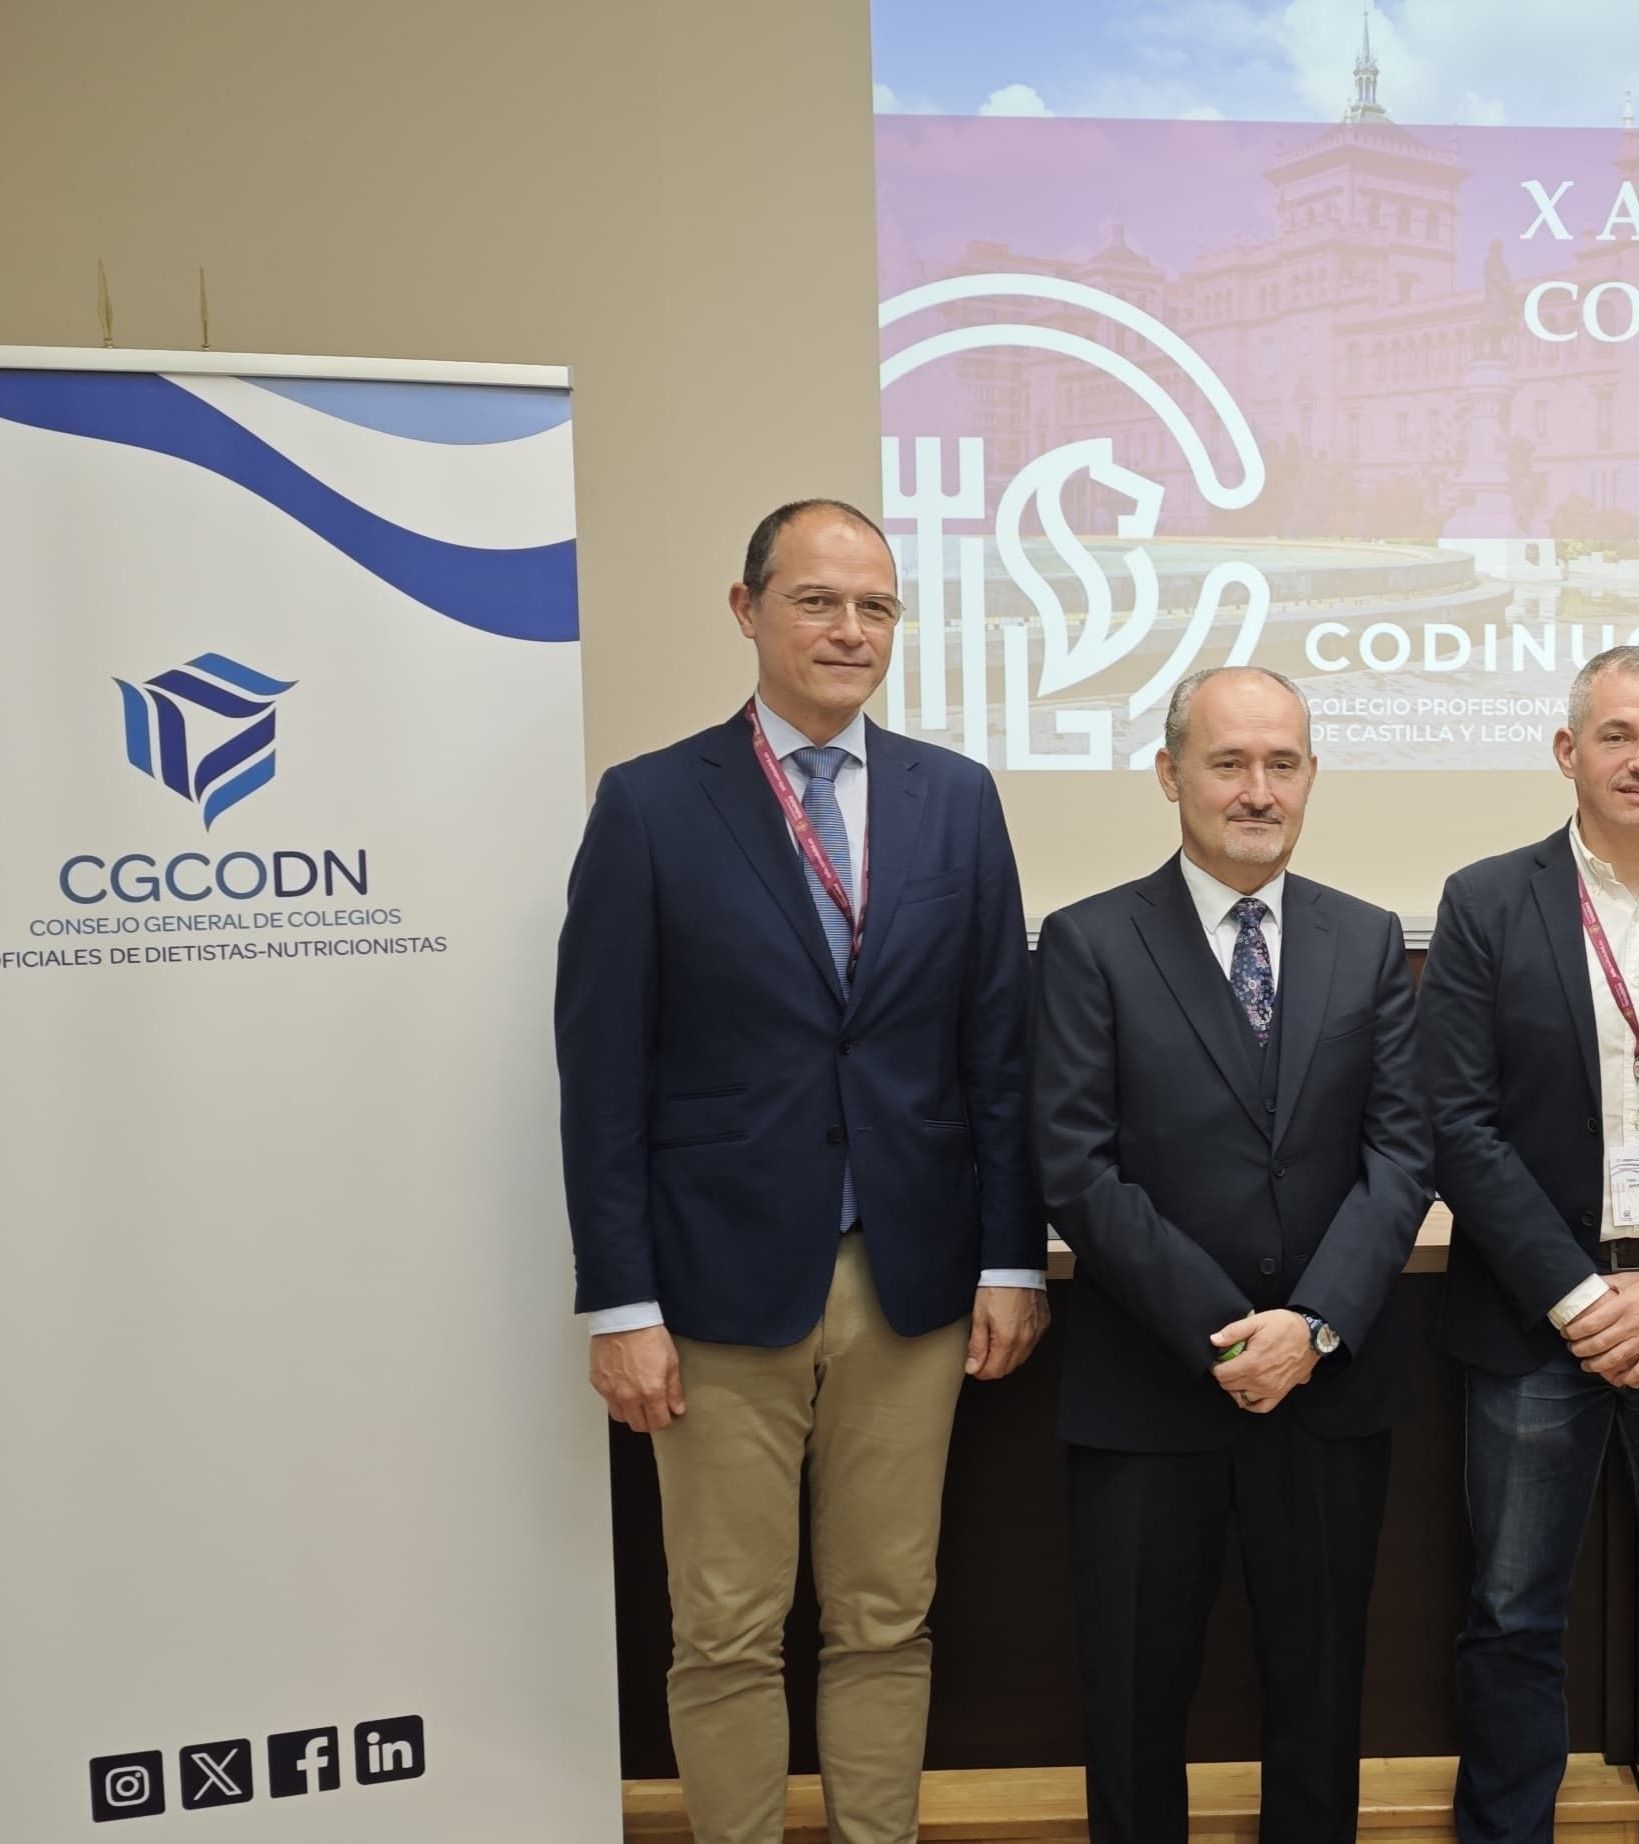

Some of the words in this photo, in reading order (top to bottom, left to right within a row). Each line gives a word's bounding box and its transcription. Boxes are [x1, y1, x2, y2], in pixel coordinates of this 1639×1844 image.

[1519, 180, 1574, 241] X
[1308, 697, 1411, 716] COLEGIO
[1417, 697, 1568, 716] PROFESIONA
[1346, 724, 1454, 742] CASTILLA
[1459, 724, 1476, 742] Y
[1481, 720, 1544, 742] LEÓN
[58, 848, 370, 905] CGCODN
[29, 916, 140, 937] CONSEJO
[144, 913, 250, 932] GENERAL
[253, 912, 284, 929] DE
[287, 908, 403, 928] COLEGIOS
[0, 948, 103, 969] FICIALES
[109, 947, 142, 965] DE
[145, 936, 448, 964] DIETISTAS-NUTRICIONISTAS
